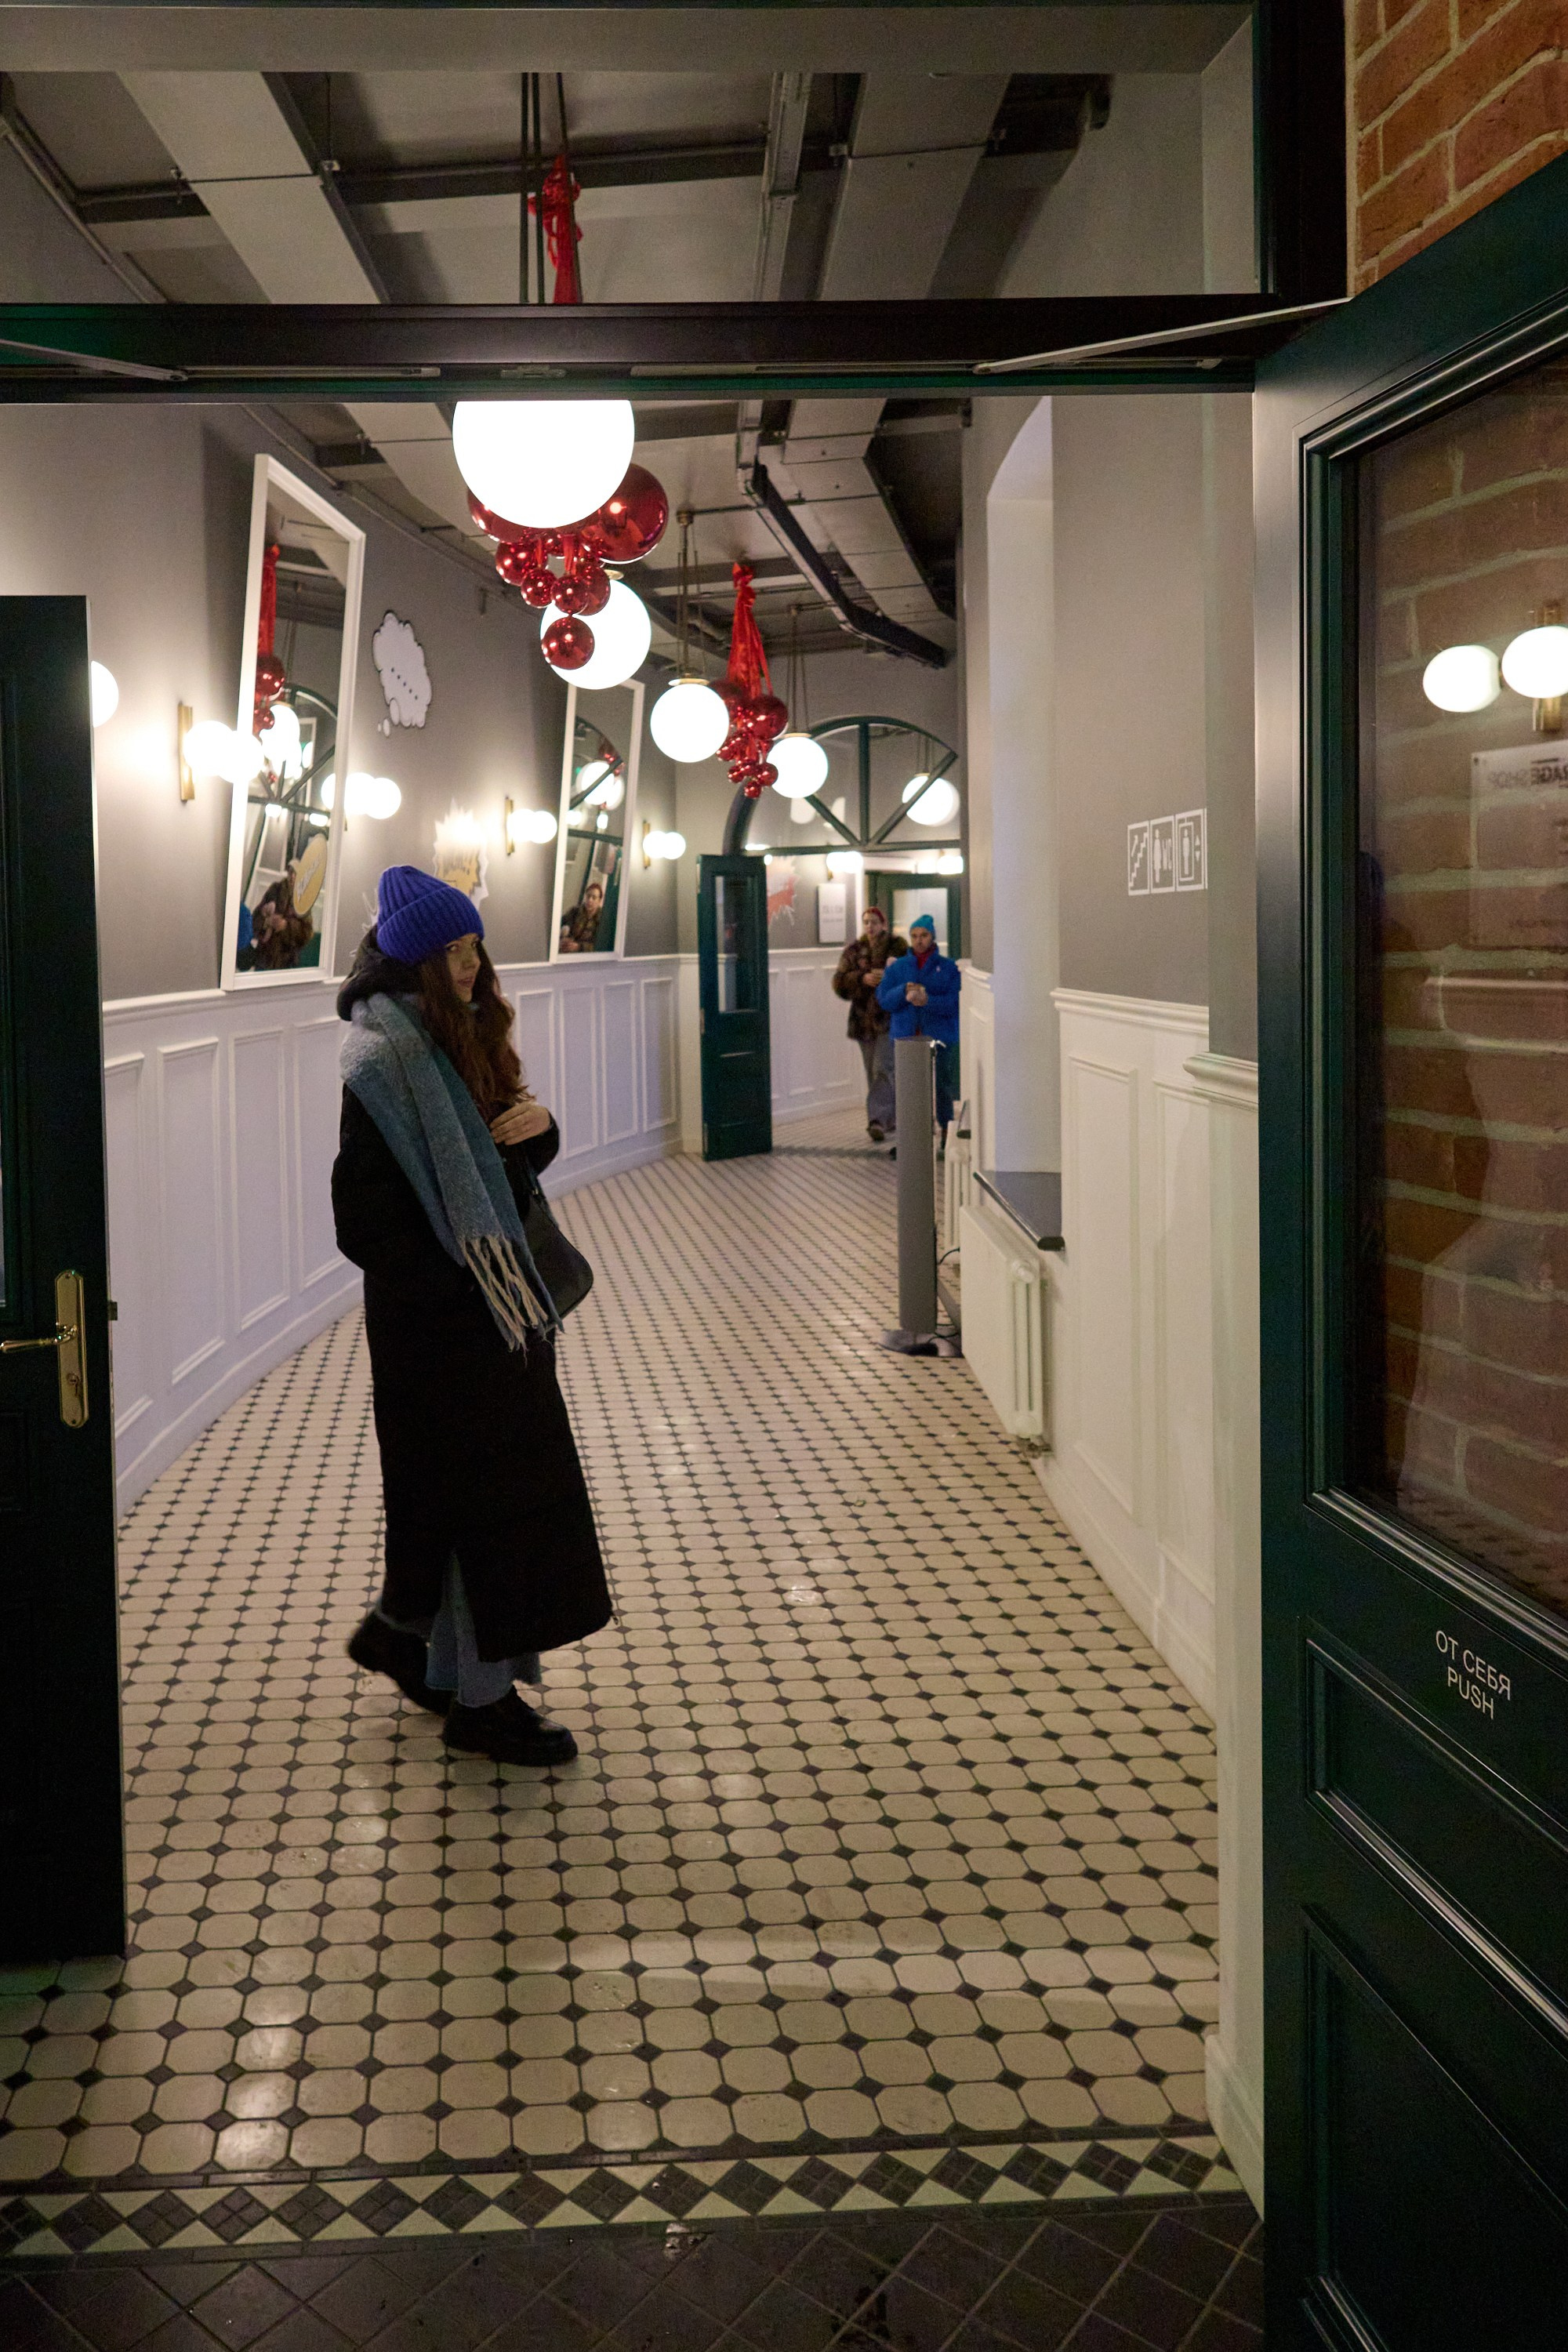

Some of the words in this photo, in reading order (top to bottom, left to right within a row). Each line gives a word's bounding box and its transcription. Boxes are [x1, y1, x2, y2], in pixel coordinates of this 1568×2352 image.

[1436, 1630, 1459, 1661] ОТ
[1463, 1650, 1511, 1701] СЕБЯ
[1447, 1666, 1494, 1720] PUSH
